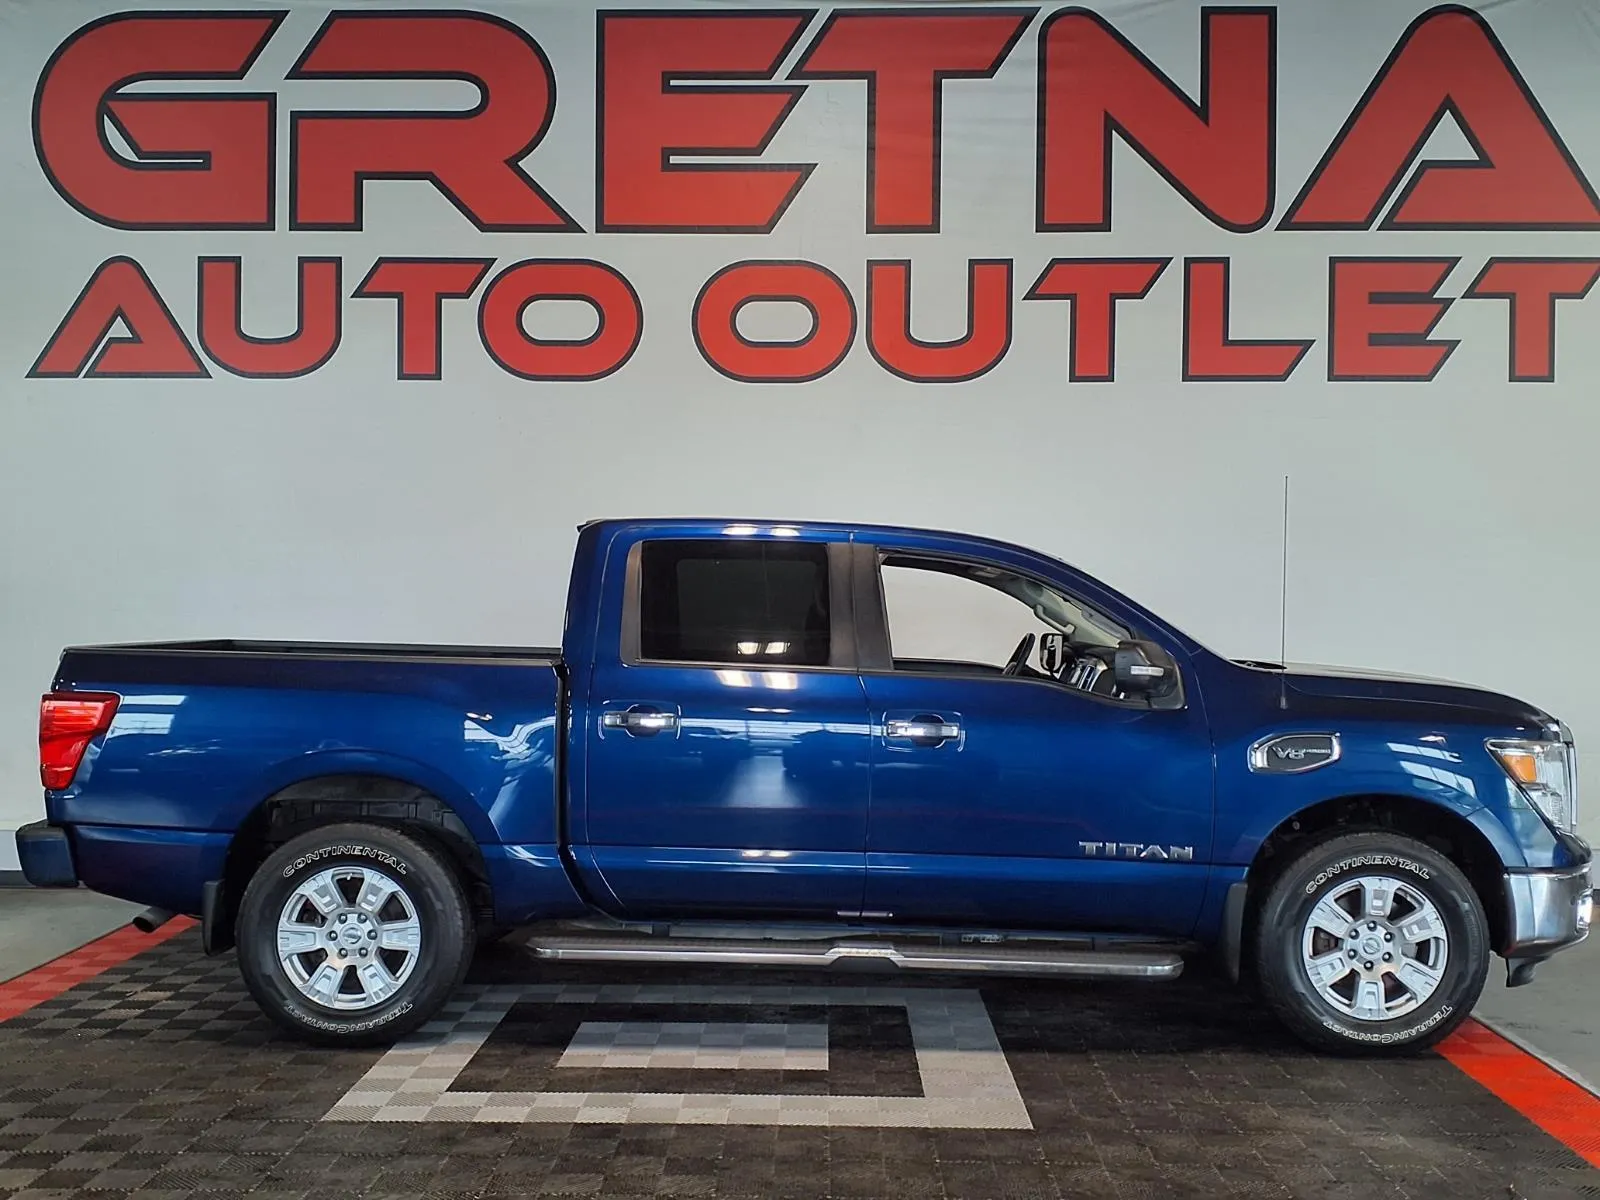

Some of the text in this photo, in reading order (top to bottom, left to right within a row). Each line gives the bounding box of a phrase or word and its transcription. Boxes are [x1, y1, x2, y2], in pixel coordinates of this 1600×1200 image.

[31, 4, 1600, 234] GRETNA
[24, 255, 1600, 382] AUTO OUTLET
[1272, 746, 1305, 760] V8
[282, 845, 408, 878] CONTINENTAL
[1079, 841, 1193, 860] TITAN
[1305, 855, 1431, 894] CONTINENTAL
